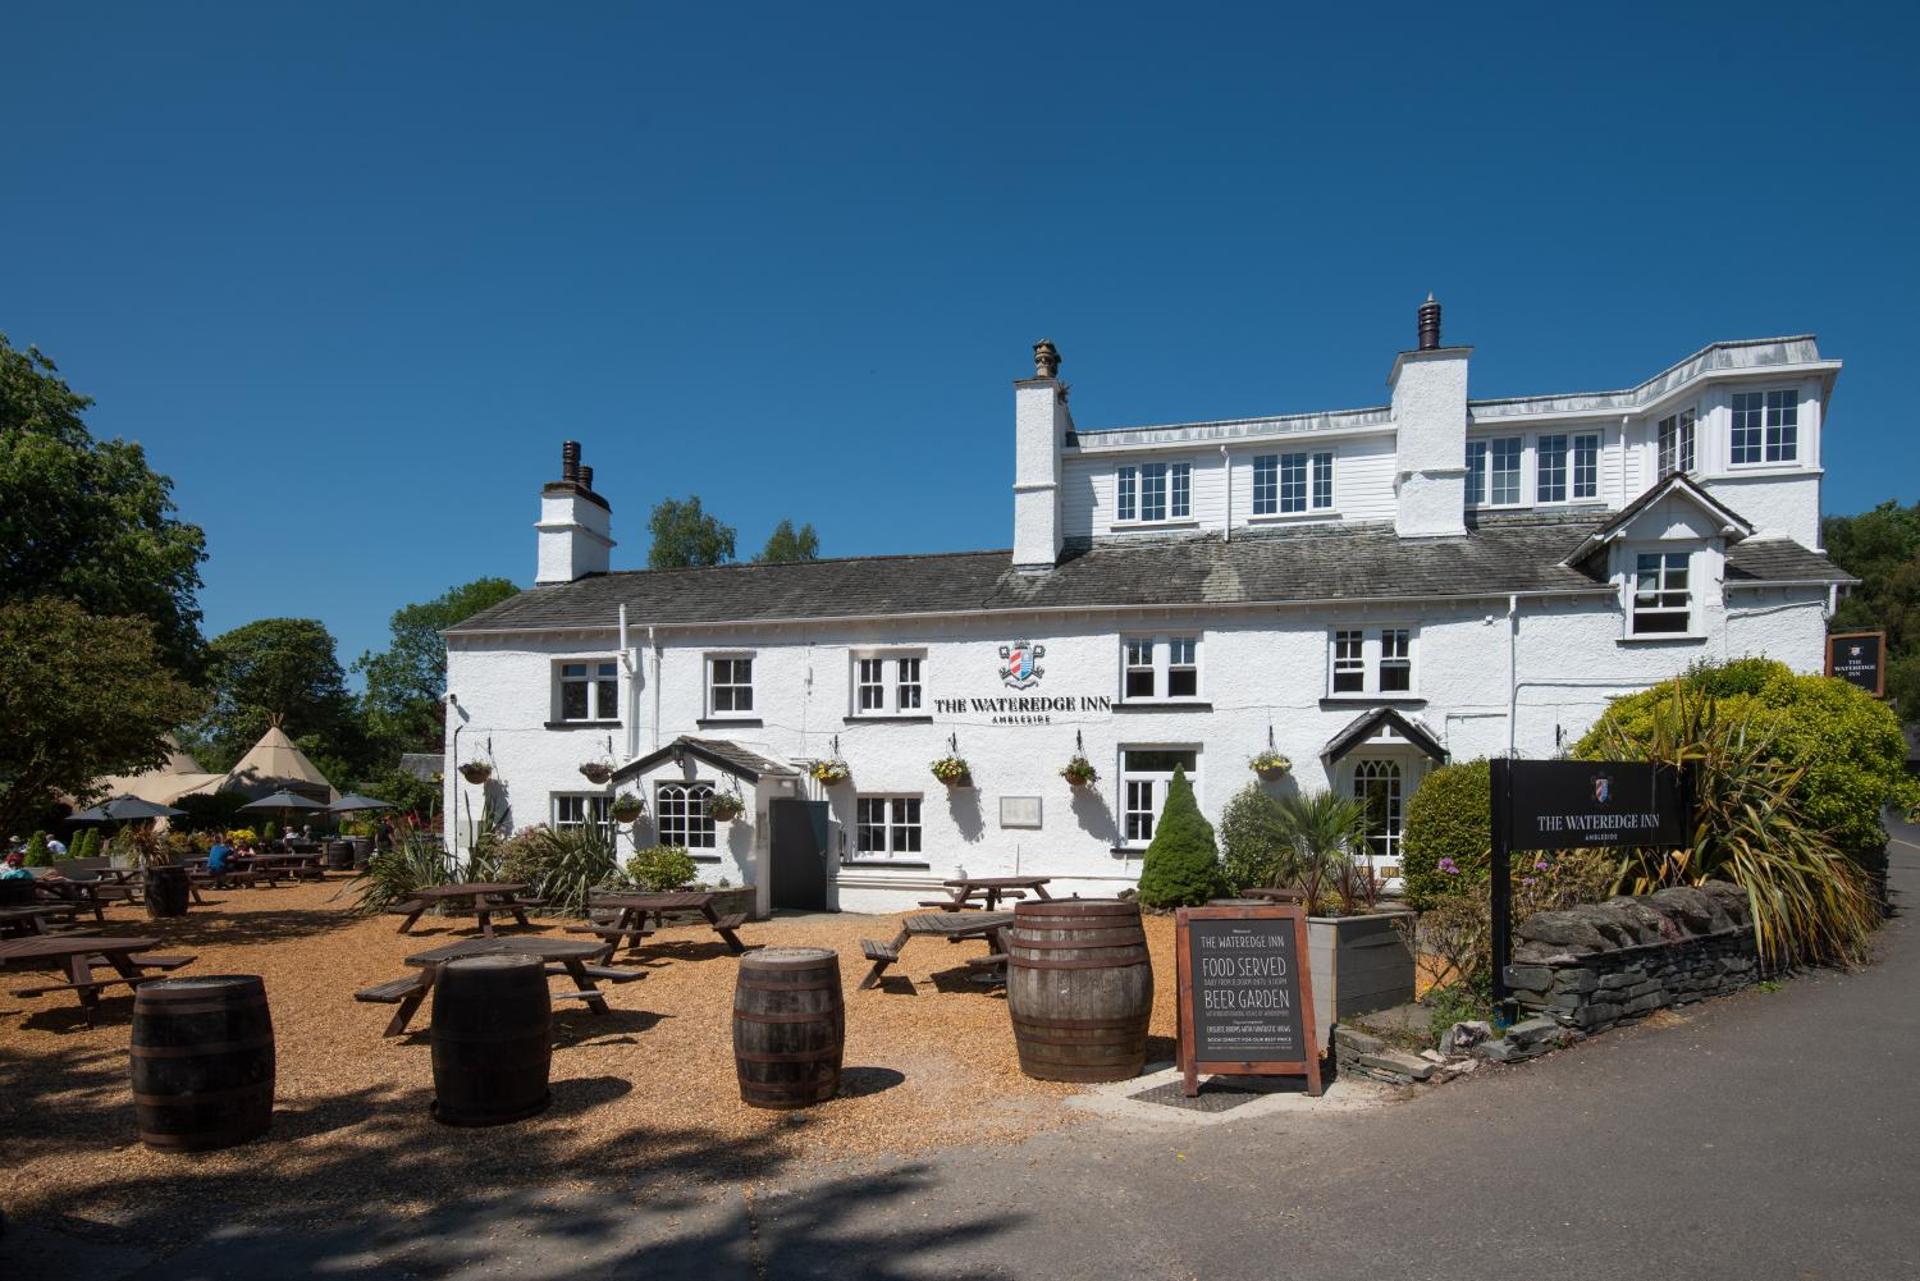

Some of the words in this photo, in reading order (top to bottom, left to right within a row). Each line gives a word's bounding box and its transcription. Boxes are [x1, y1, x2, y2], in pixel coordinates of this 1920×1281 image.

[934, 699, 967, 713] THE
[970, 697, 1076, 713] WATEREDGE
[1081, 696, 1111, 711] INN
[992, 715, 1051, 725] AMBLESIDE
[1537, 816, 1563, 831] THE
[1565, 814, 1638, 830] WATEREDGE
[1640, 814, 1660, 828] INN
[1201, 936, 1216, 948] THE
[1218, 936, 1267, 948] WATEREDGE
[1268, 935, 1285, 947] INN
[1202, 958, 1235, 977] FOOD
[1237, 957, 1286, 977] SERVED
[1204, 990, 1235, 1009] BEER
[1238, 989, 1290, 1008] GARDEN
